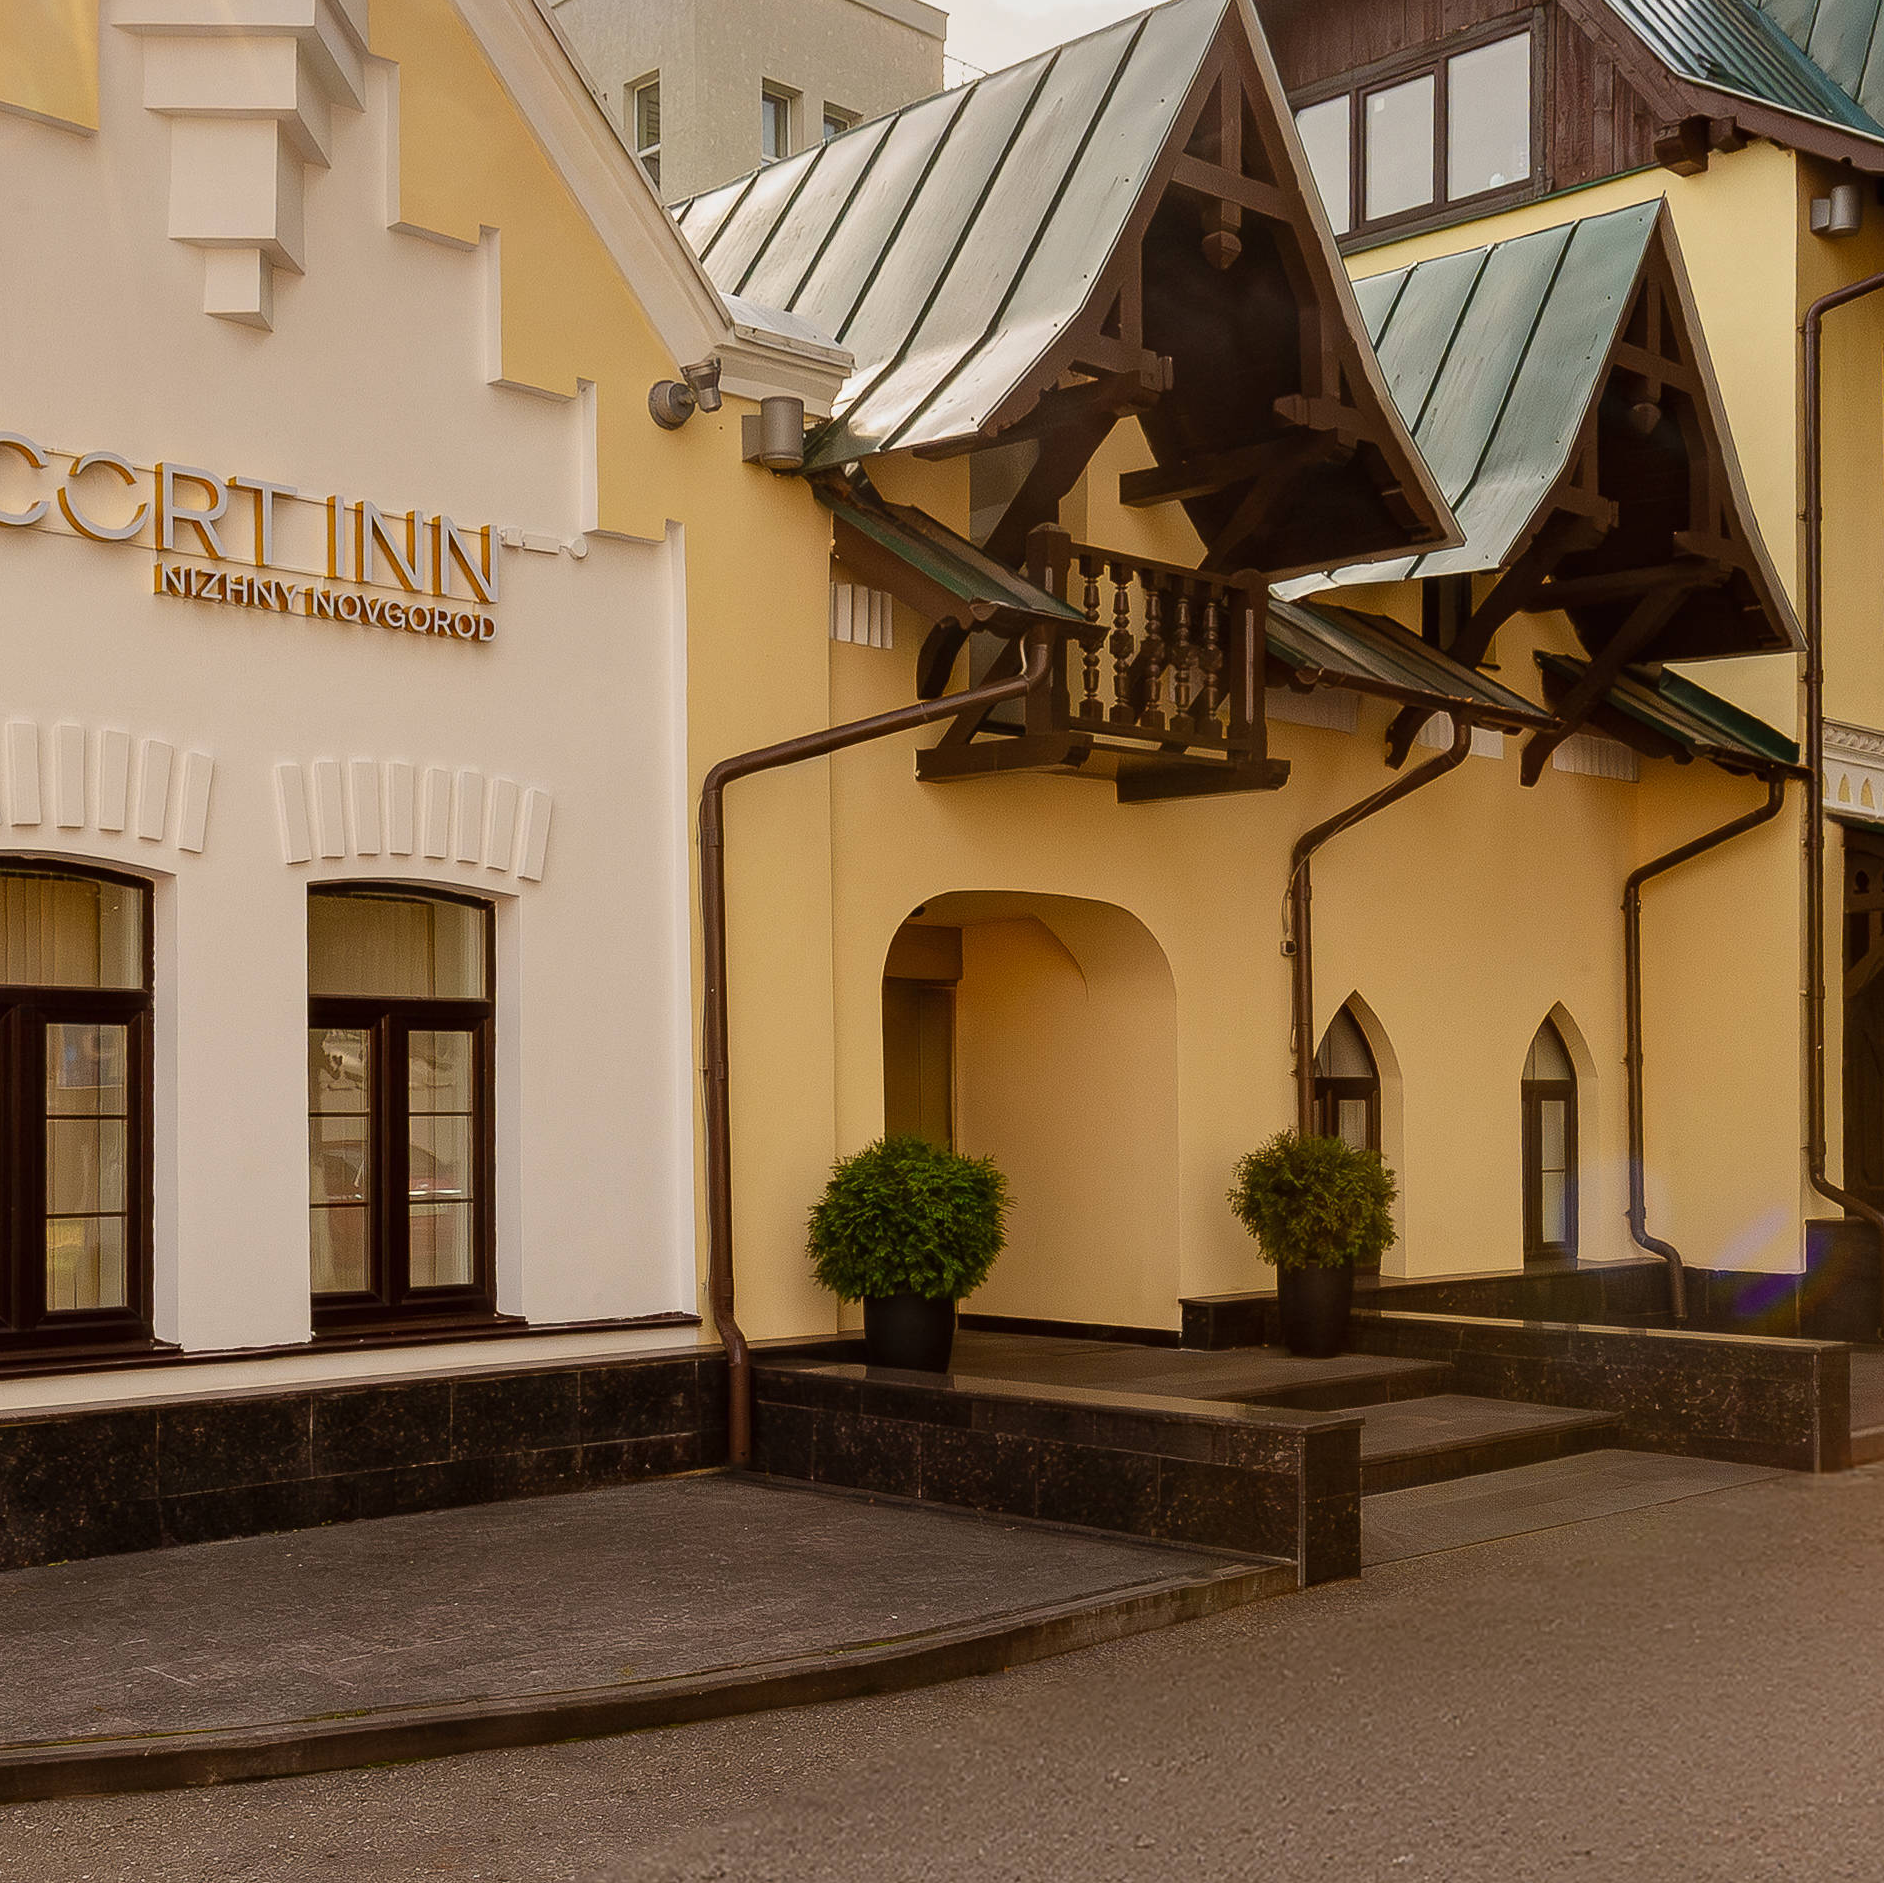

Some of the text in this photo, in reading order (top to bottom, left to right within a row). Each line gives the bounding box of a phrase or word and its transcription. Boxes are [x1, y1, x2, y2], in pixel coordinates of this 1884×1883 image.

[326, 494, 499, 604] INN
[153, 562, 497, 642] NIZHNY NOVGOROD
